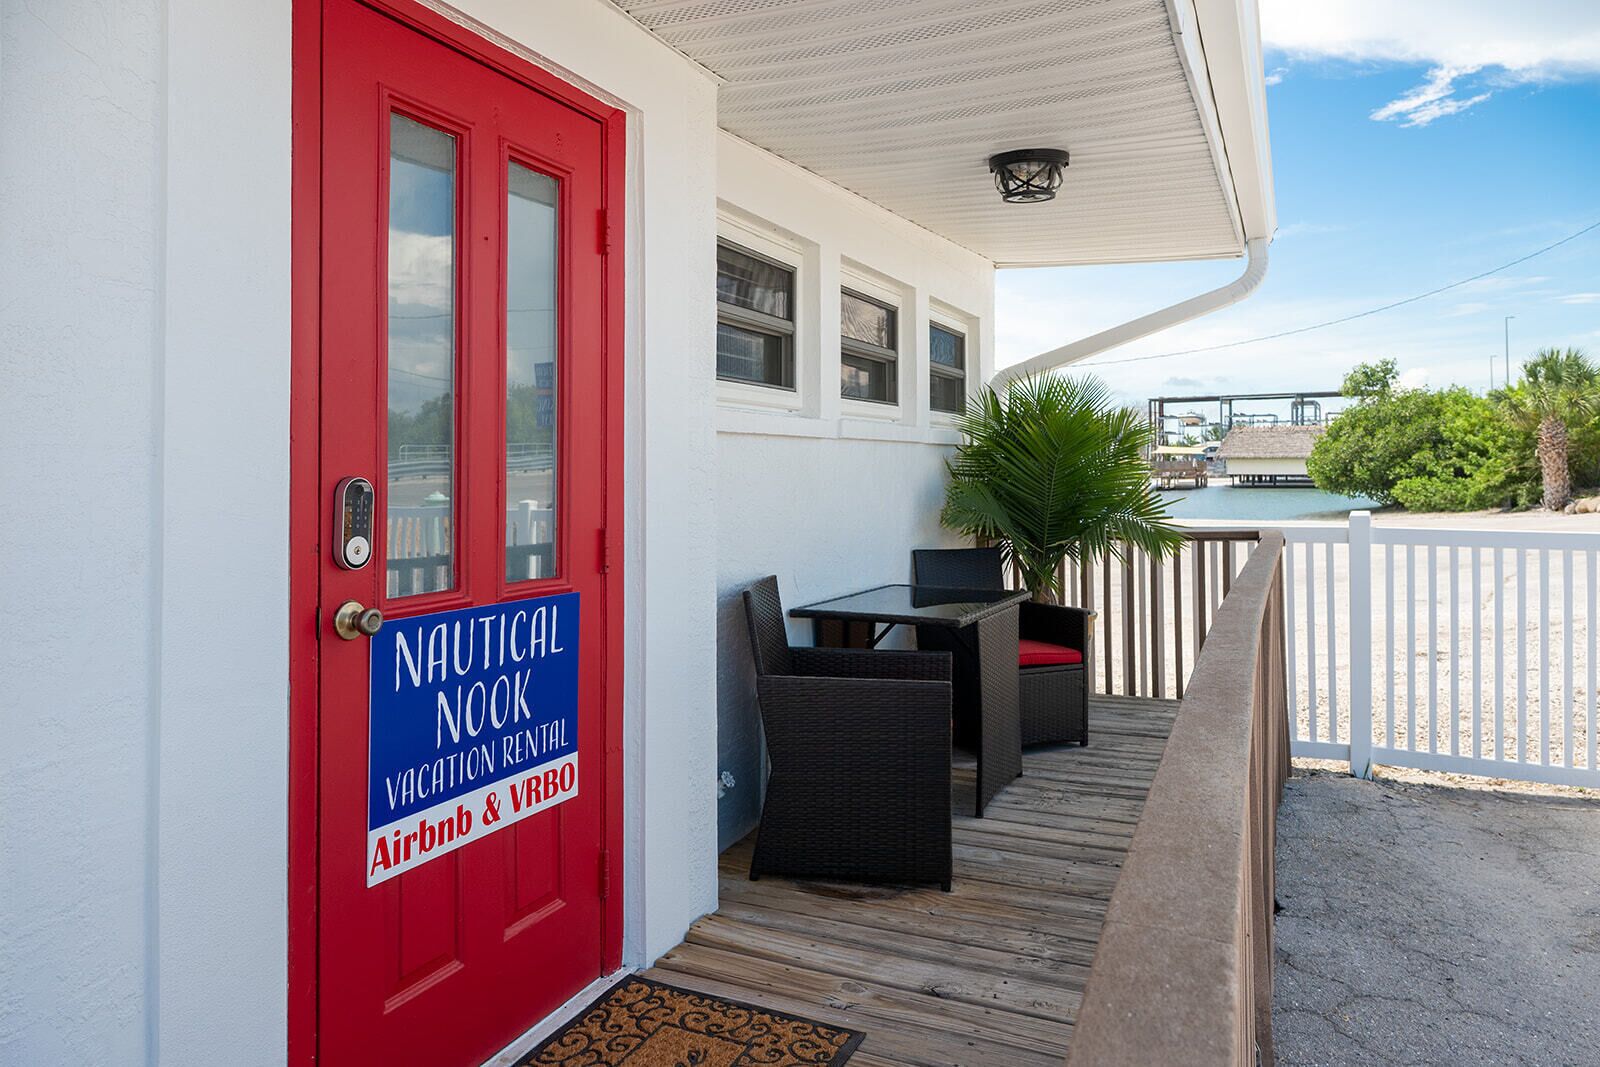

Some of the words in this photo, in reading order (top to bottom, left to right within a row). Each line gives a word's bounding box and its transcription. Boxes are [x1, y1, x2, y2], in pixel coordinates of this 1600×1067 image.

[395, 605, 564, 692] NAUTICAL
[436, 668, 532, 749] NOOK
[385, 740, 496, 811] VACATION
[502, 718, 569, 769] RENTAL
[370, 804, 473, 877] Airbnb
[482, 791, 501, 826] &
[509, 762, 576, 814] VRBO
